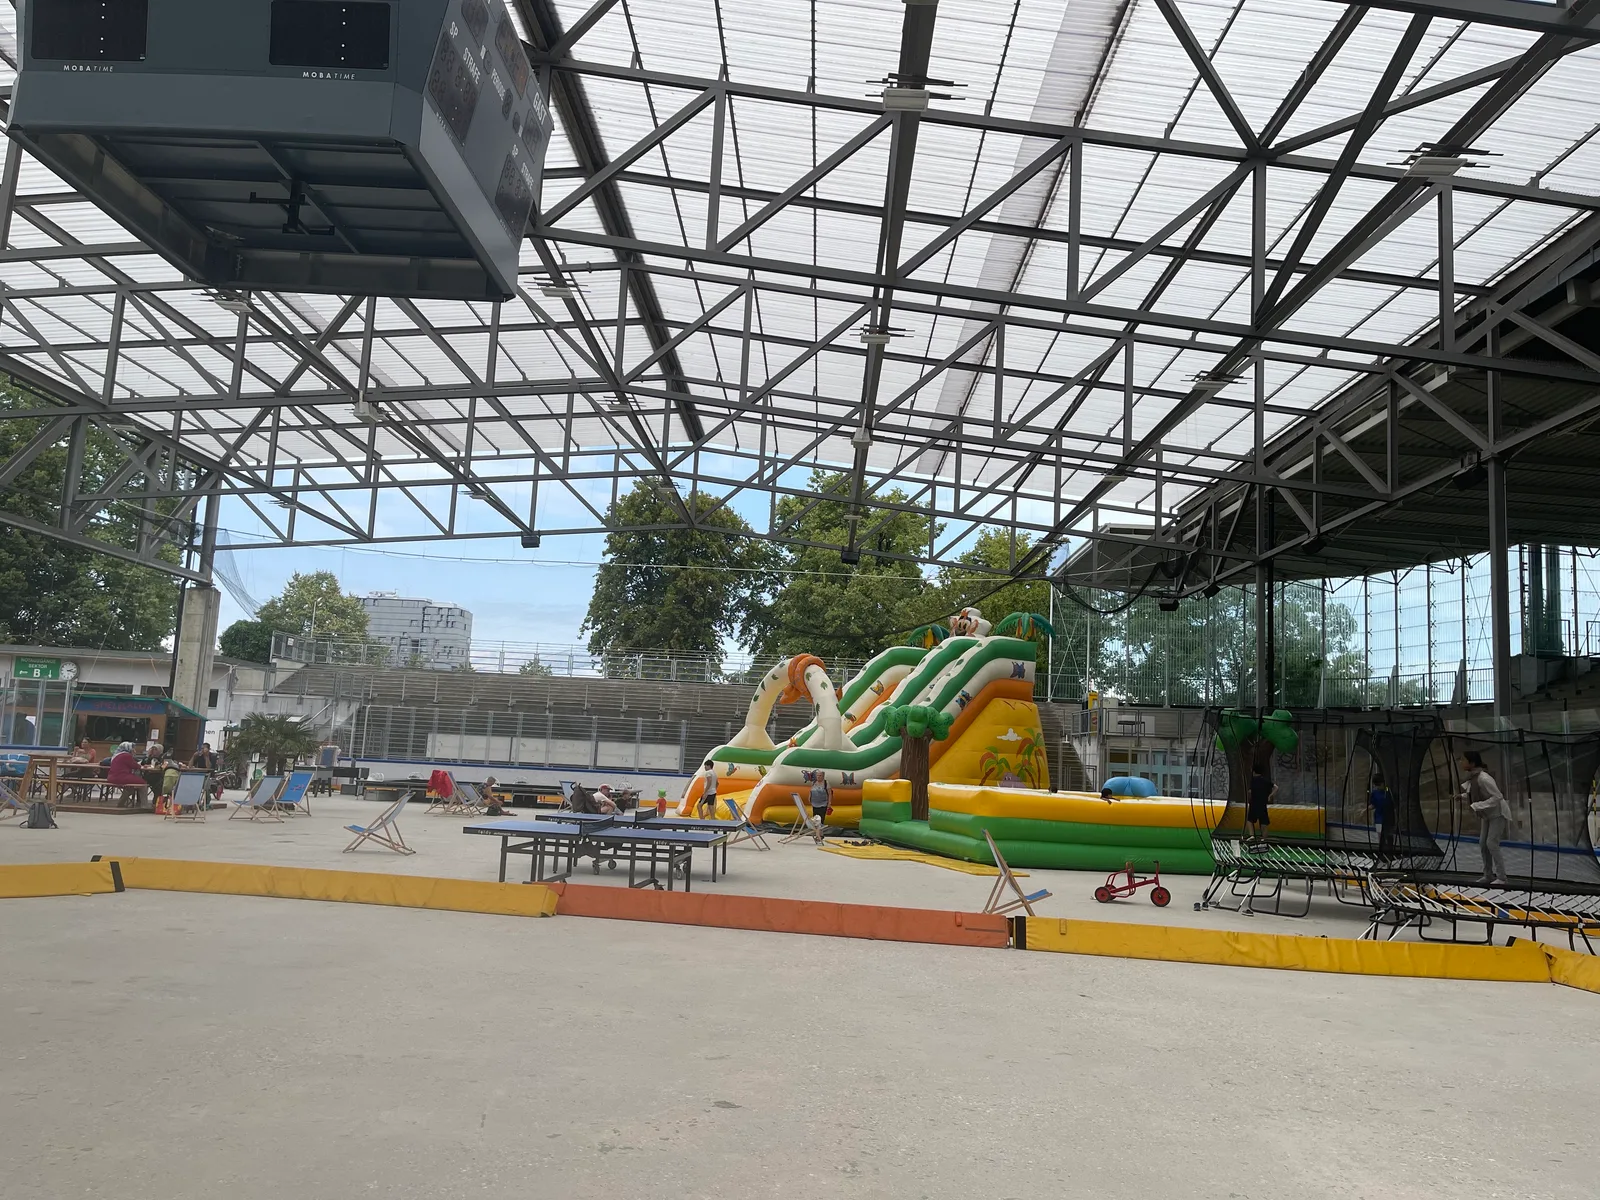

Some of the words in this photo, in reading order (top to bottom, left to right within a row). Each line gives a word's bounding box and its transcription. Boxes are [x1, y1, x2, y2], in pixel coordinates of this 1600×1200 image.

[63, 65, 114, 73] MOBATIME
[462, 47, 481, 85] STRAFE
[302, 71, 356, 80] MOBATIME
[533, 92, 547, 125] GAST
[33, 668, 41, 678] B
